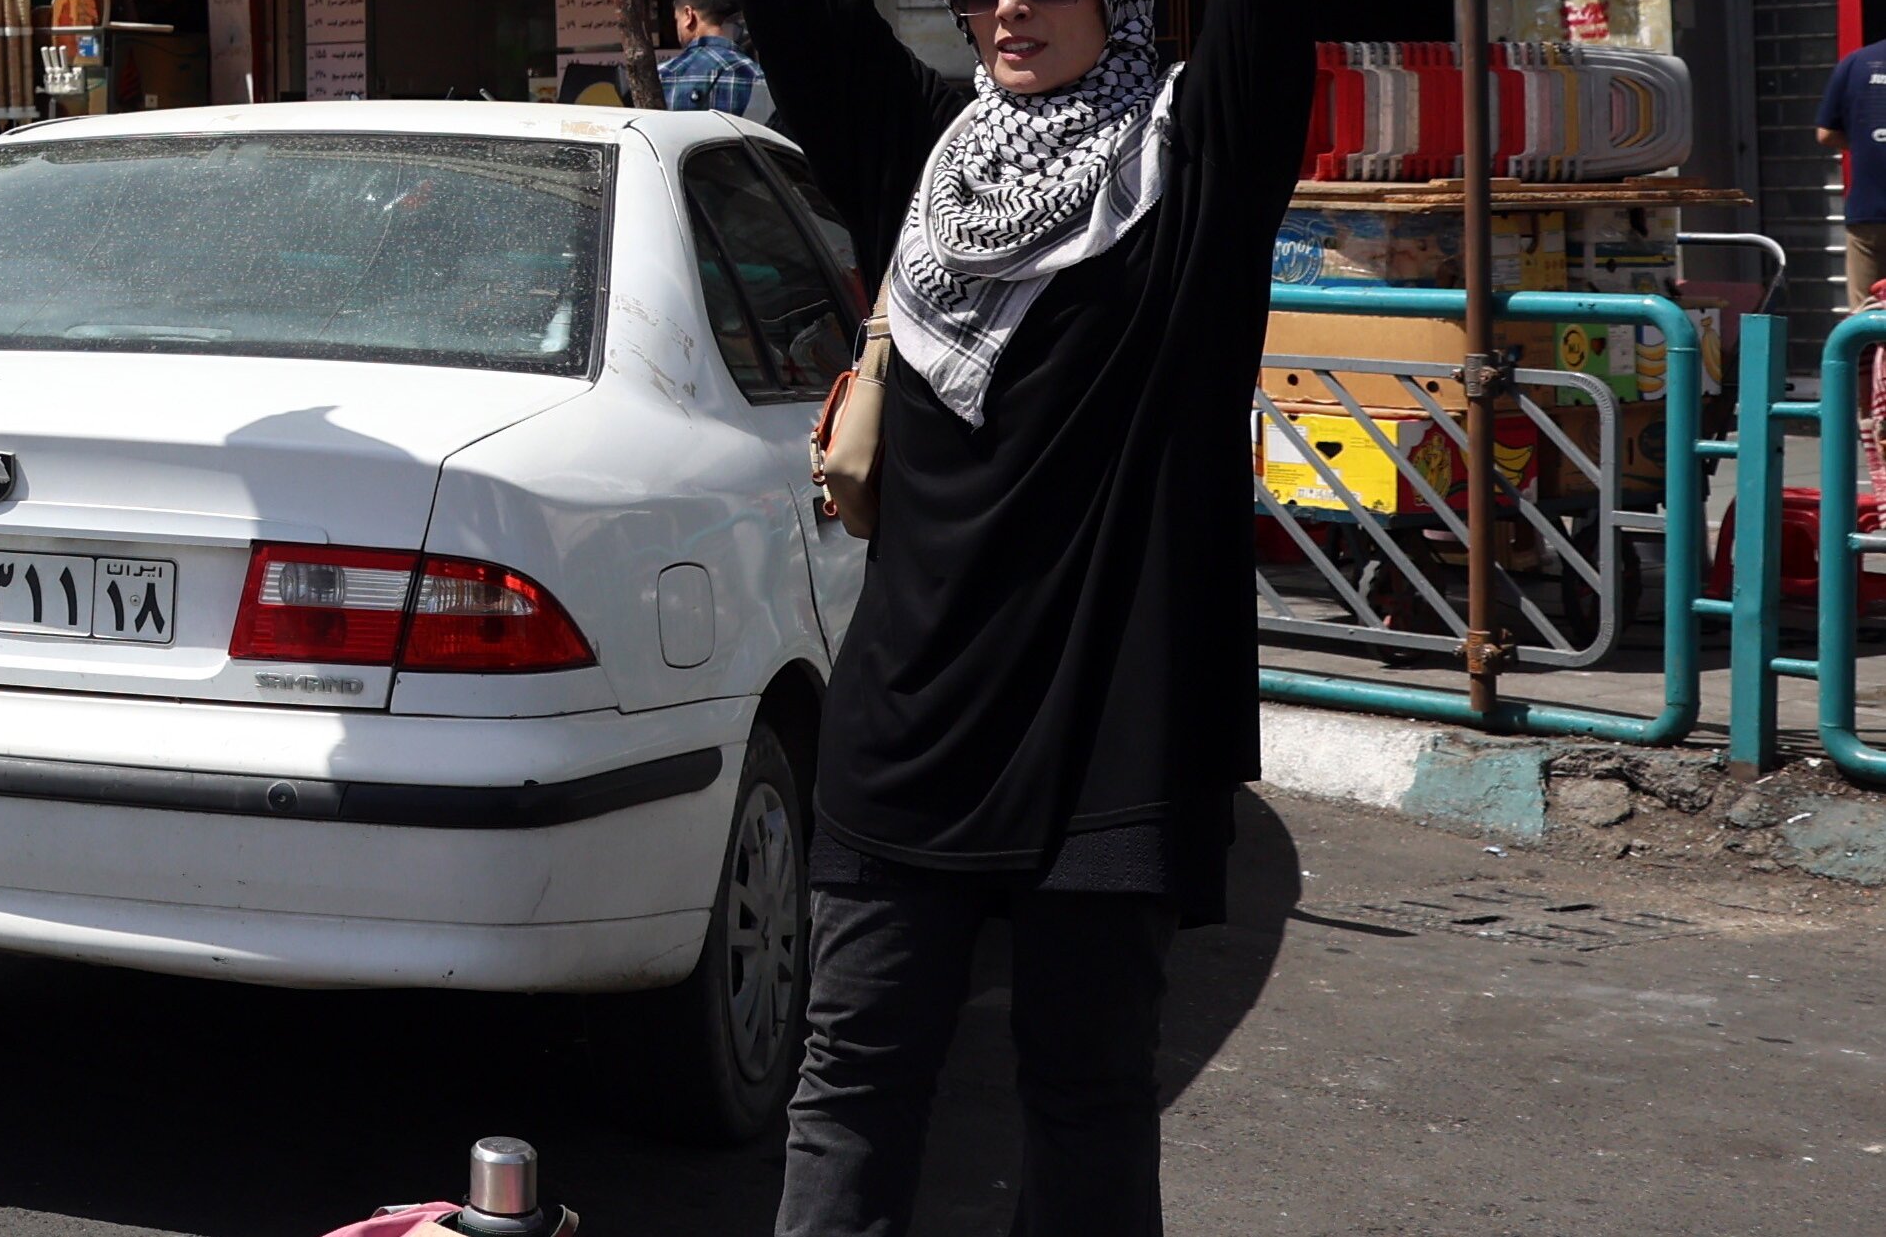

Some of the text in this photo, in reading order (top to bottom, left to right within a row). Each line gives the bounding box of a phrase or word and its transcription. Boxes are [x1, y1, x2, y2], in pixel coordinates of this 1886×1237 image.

[106, 563, 164, 579] ایران
[106, 579, 166, 635] ۱۸
[254, 671, 364, 695] SAMAND
